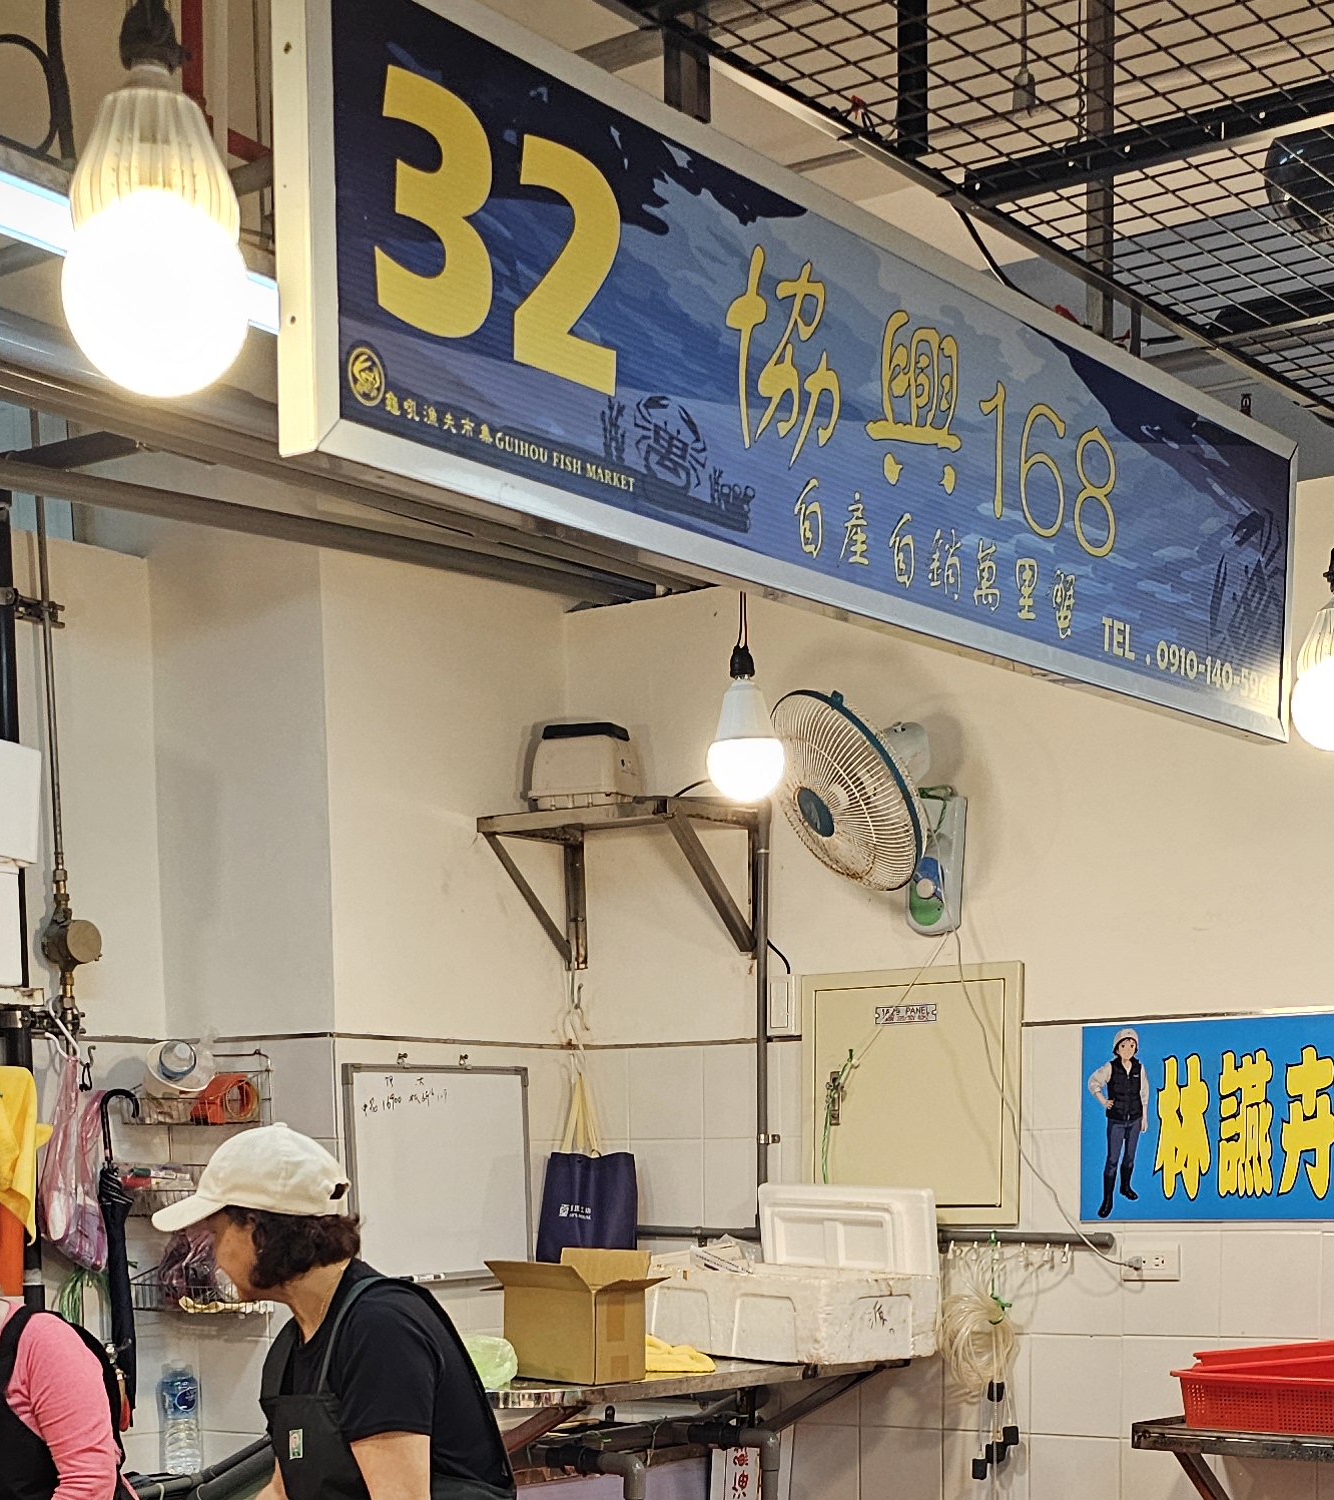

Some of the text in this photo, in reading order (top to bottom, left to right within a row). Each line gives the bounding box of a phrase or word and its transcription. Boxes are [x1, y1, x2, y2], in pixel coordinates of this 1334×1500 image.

[374, 63, 621, 397] 32
[495, 432, 548, 464] GUIHOU
[552, 450, 582, 475] FISH
[585, 462, 635, 492] MARKET
[1101, 616, 1135, 661] TEL
